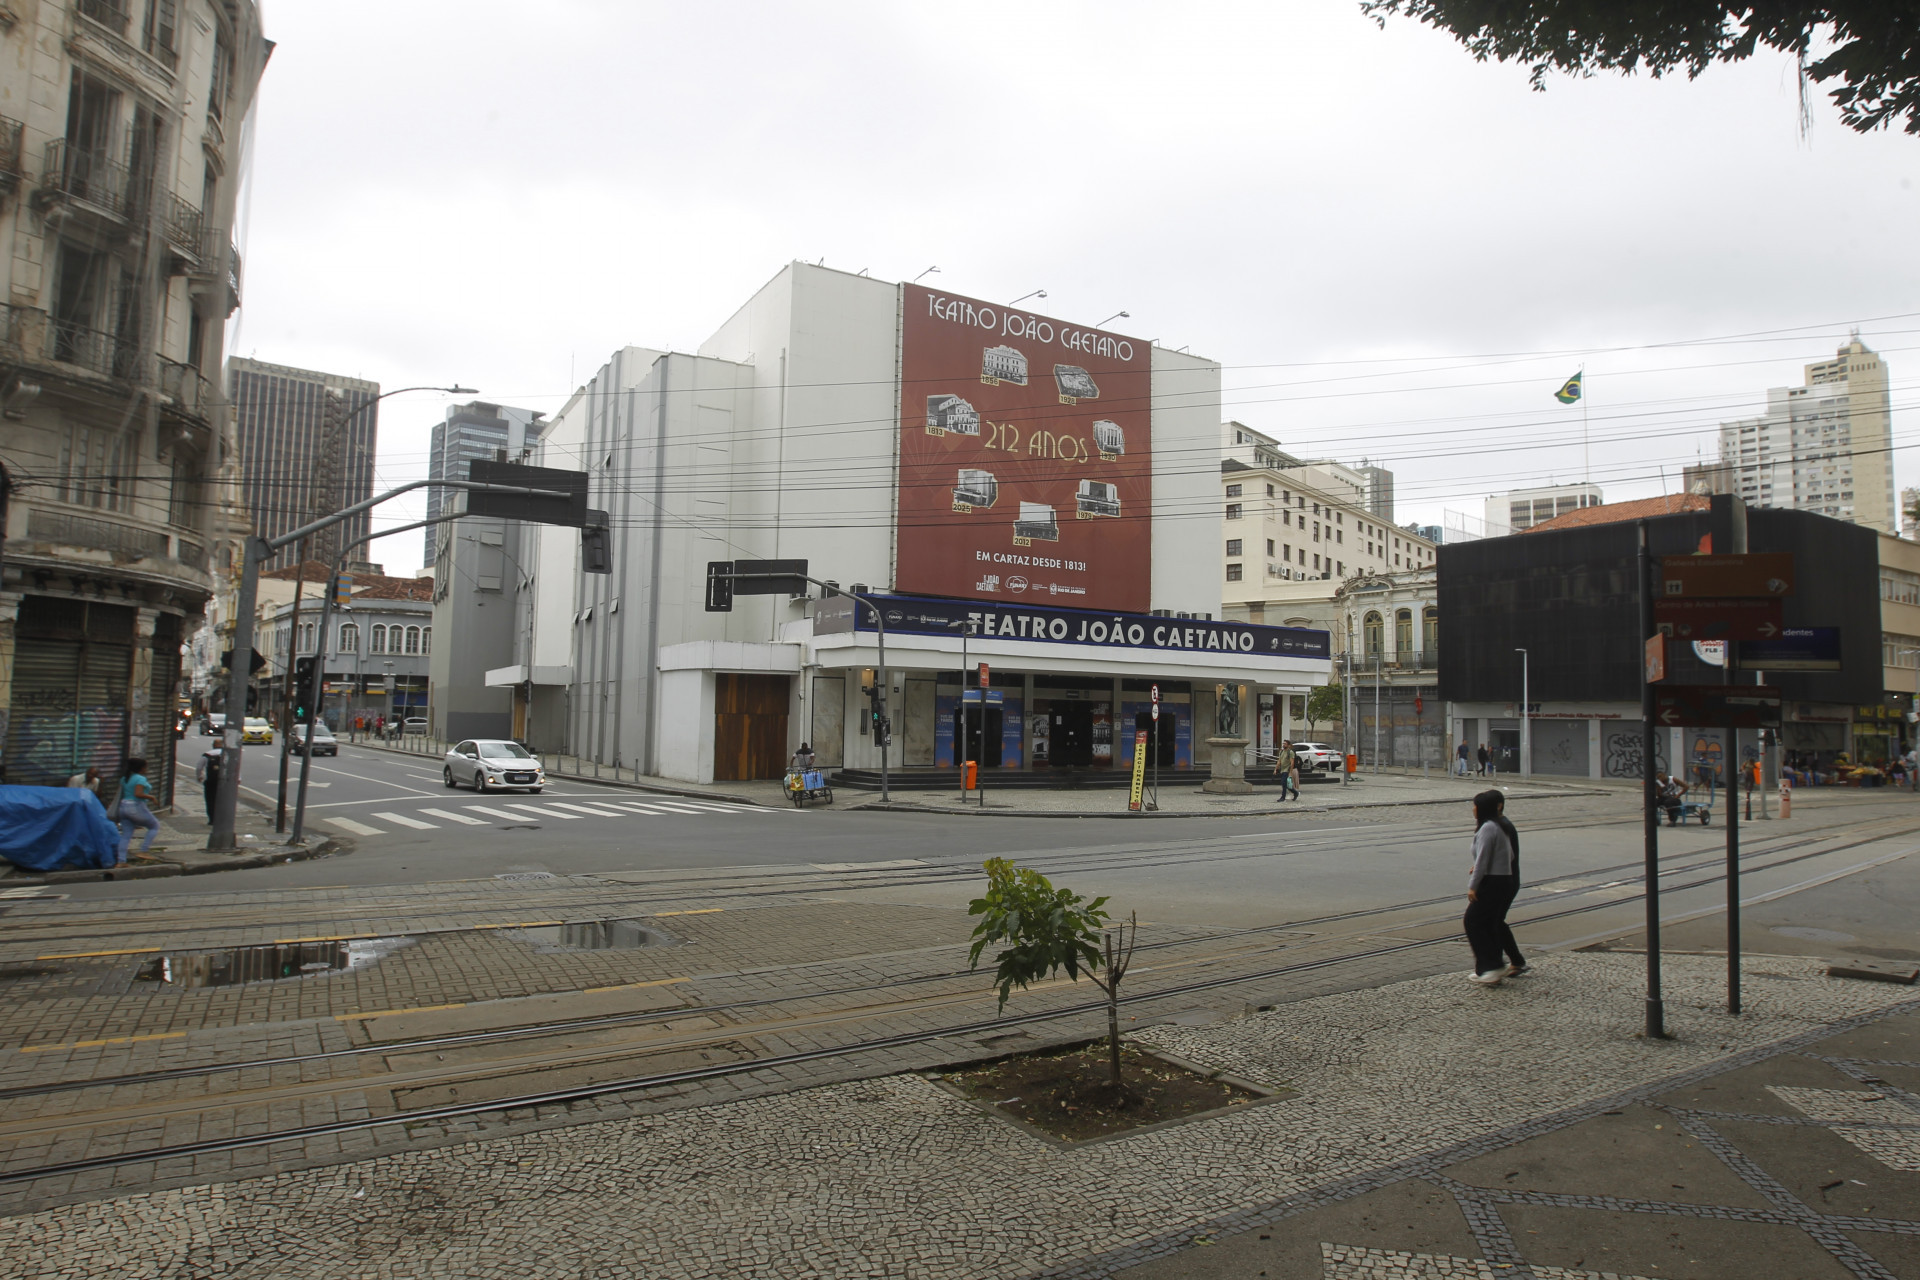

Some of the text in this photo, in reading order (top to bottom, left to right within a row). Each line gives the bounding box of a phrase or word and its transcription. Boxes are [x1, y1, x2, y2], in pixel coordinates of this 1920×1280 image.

[928, 294, 1133, 361] TEATRO JOÃO CAETANO
[981, 376, 998, 385] 1856
[1060, 396, 1075, 405] 1928
[927, 427, 943, 436] 1813
[985, 420, 1088, 463] 212 ANOS
[953, 503, 971, 512] 2025
[1014, 538, 1030, 546] 2012
[976, 550, 1086, 571] EM CARTAZ DESDE 1813!
[968, 612, 1255, 652] TEATRO JOÃO CAETANO
